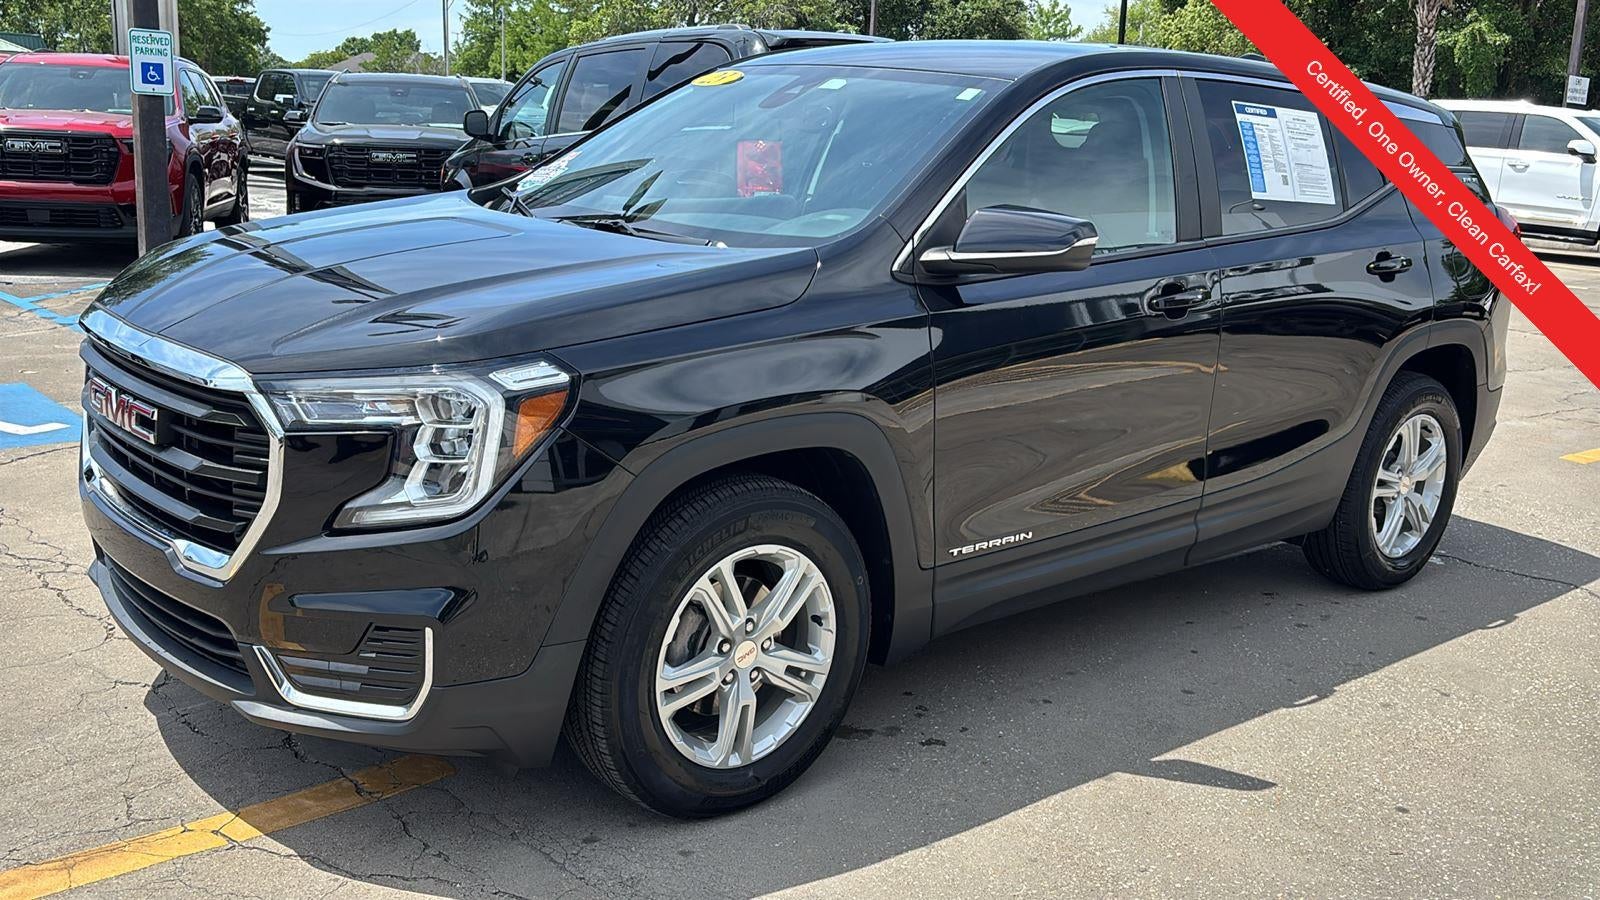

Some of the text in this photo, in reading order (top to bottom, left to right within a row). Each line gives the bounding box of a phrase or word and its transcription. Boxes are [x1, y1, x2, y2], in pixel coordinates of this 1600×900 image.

[131, 34, 170, 47] RESERVED
[135, 46, 168, 57] PARKING
[5, 140, 62, 153] GMC
[371, 152, 417, 163] GMC
[89, 376, 158, 445] GMC
[948, 531, 1033, 557] TERRAIN
